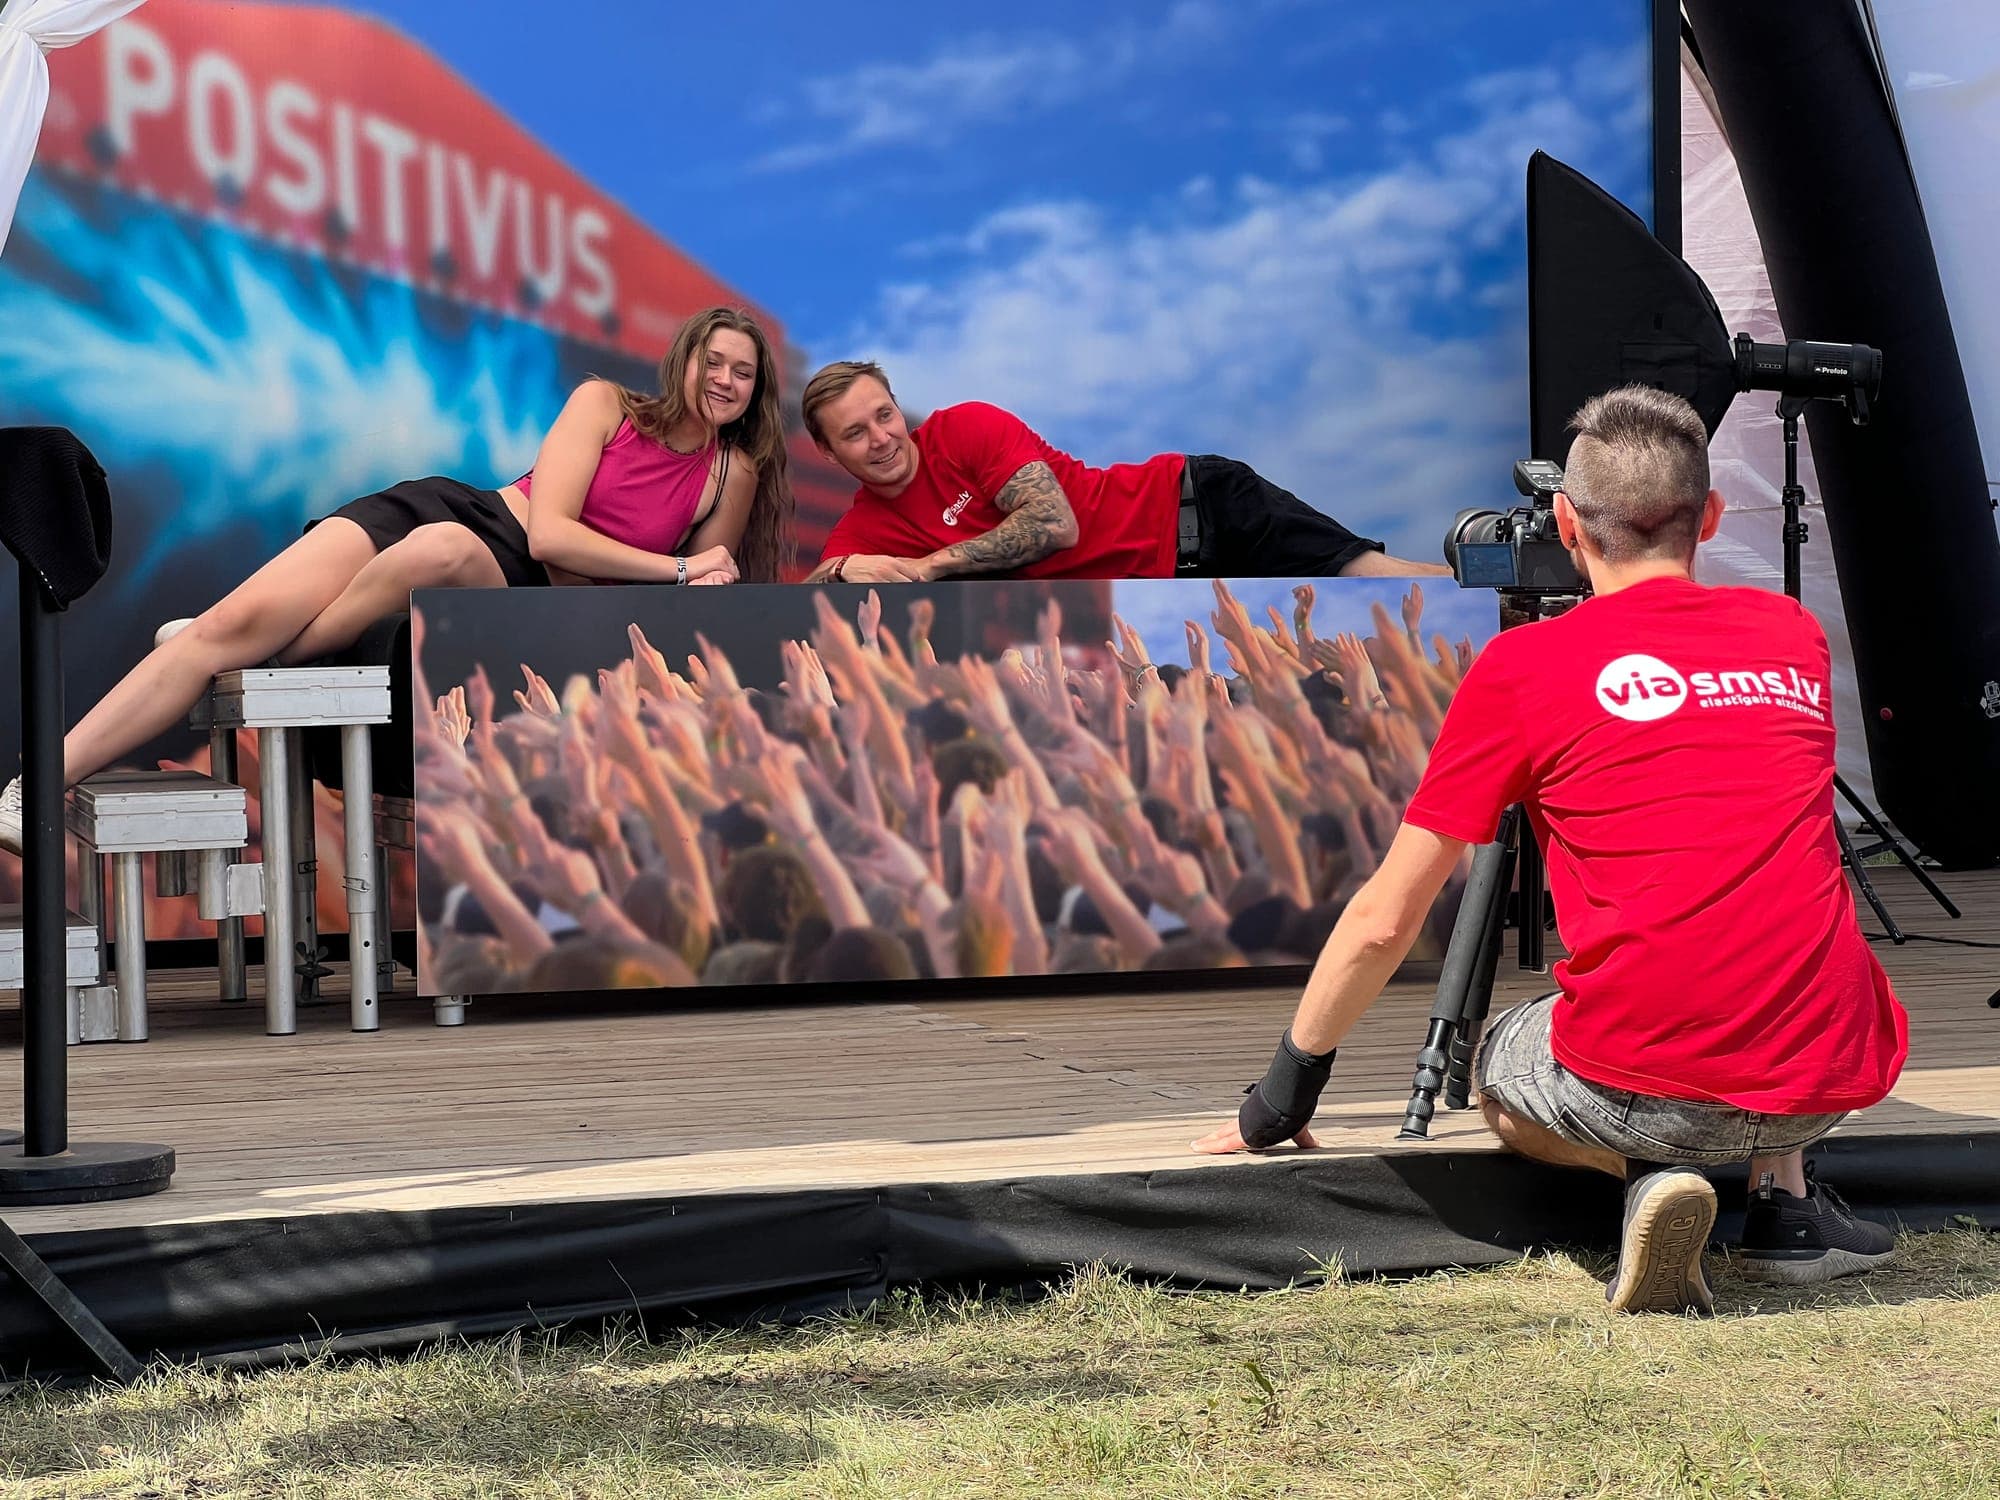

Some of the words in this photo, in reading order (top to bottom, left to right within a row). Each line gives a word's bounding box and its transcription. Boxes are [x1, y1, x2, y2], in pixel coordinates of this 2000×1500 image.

[106, 20, 619, 318] POSITIVUS
[1822, 366, 1848, 376] Profoto
[1601, 671, 1681, 706] via
[1689, 666, 1821, 706] sms.lv
